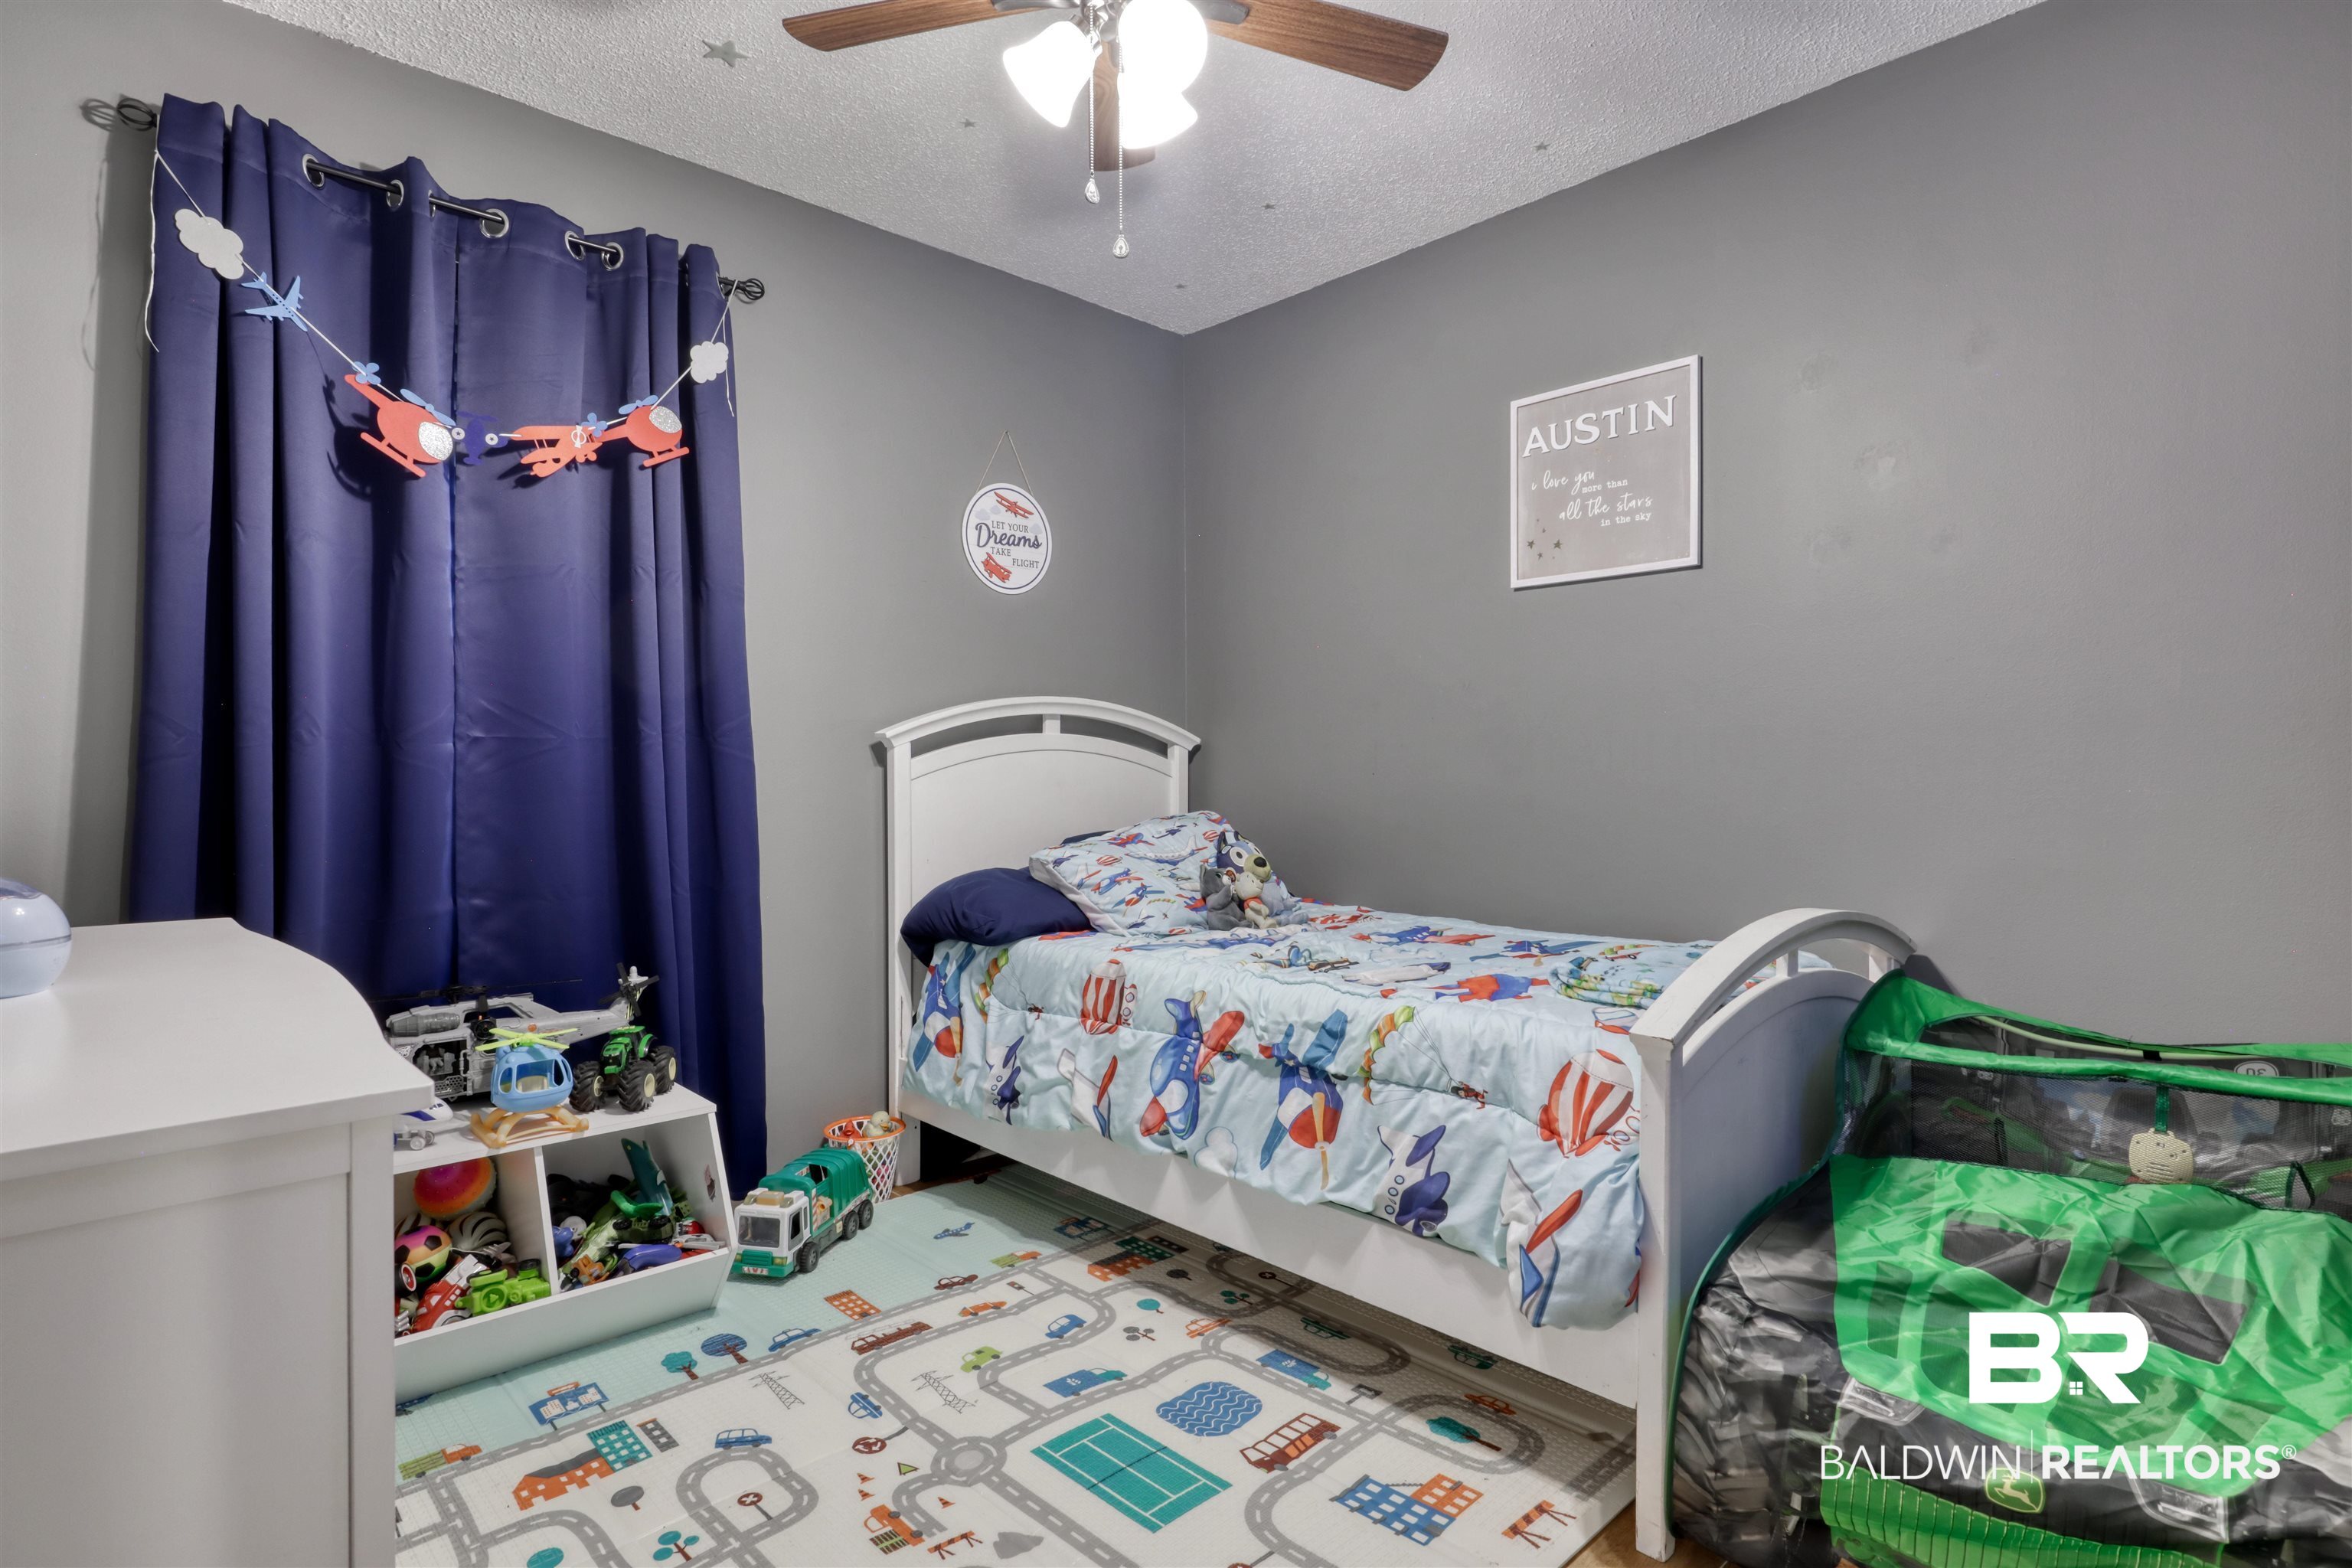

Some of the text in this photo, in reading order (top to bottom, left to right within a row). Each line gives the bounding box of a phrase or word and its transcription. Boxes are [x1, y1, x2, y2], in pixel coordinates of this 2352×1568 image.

[1522, 394, 1677, 458] AUSTIN
[1531, 469, 1595, 496] i love you
[1582, 479, 1628, 494] more than
[1559, 492, 1653, 521] all the stars
[991, 520, 1029, 534] LET YOUR
[1600, 511, 1651, 527] in the sky
[975, 522, 1043, 550] Dreams
[990, 547, 1011, 557] TAKE
[1012, 558, 1040, 569] FLIGHT
